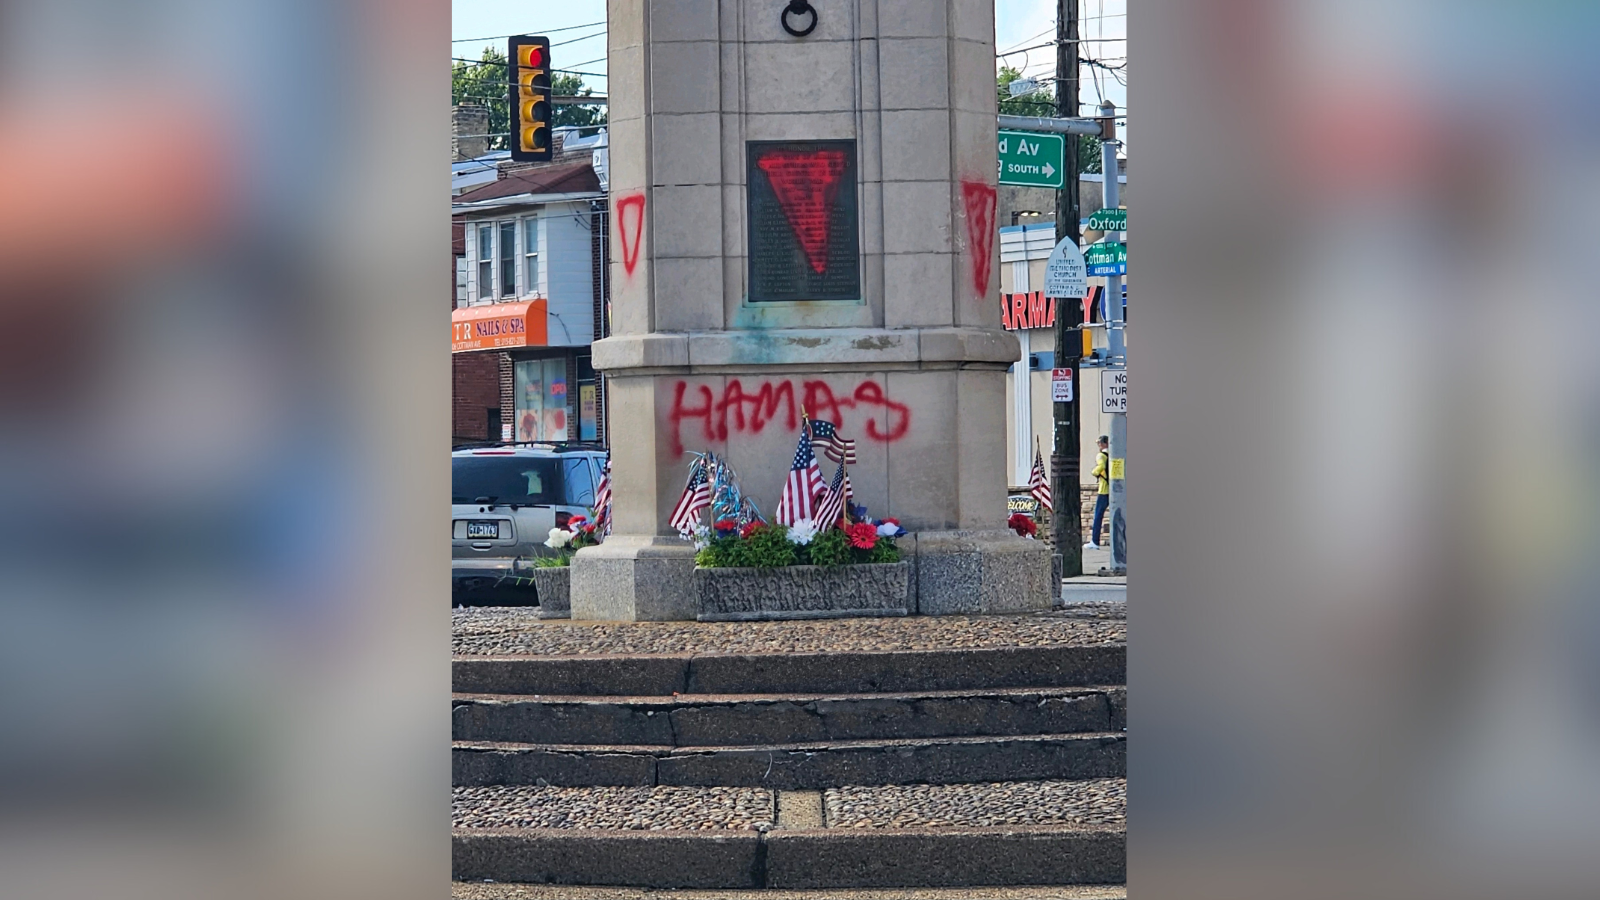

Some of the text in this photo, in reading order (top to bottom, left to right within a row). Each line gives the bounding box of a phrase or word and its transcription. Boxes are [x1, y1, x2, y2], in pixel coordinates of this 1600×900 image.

[1016, 138, 1040, 156] Av
[1008, 164, 1038, 174] SOUTH
[1089, 218, 1126, 230] Oxford
[476, 320, 500, 337] NAILS
[510, 318, 524, 334] SPA
[1106, 398, 1118, 407] ON
[671, 379, 911, 461] HAMAS
[1008, 501, 1034, 510] ELCOME
